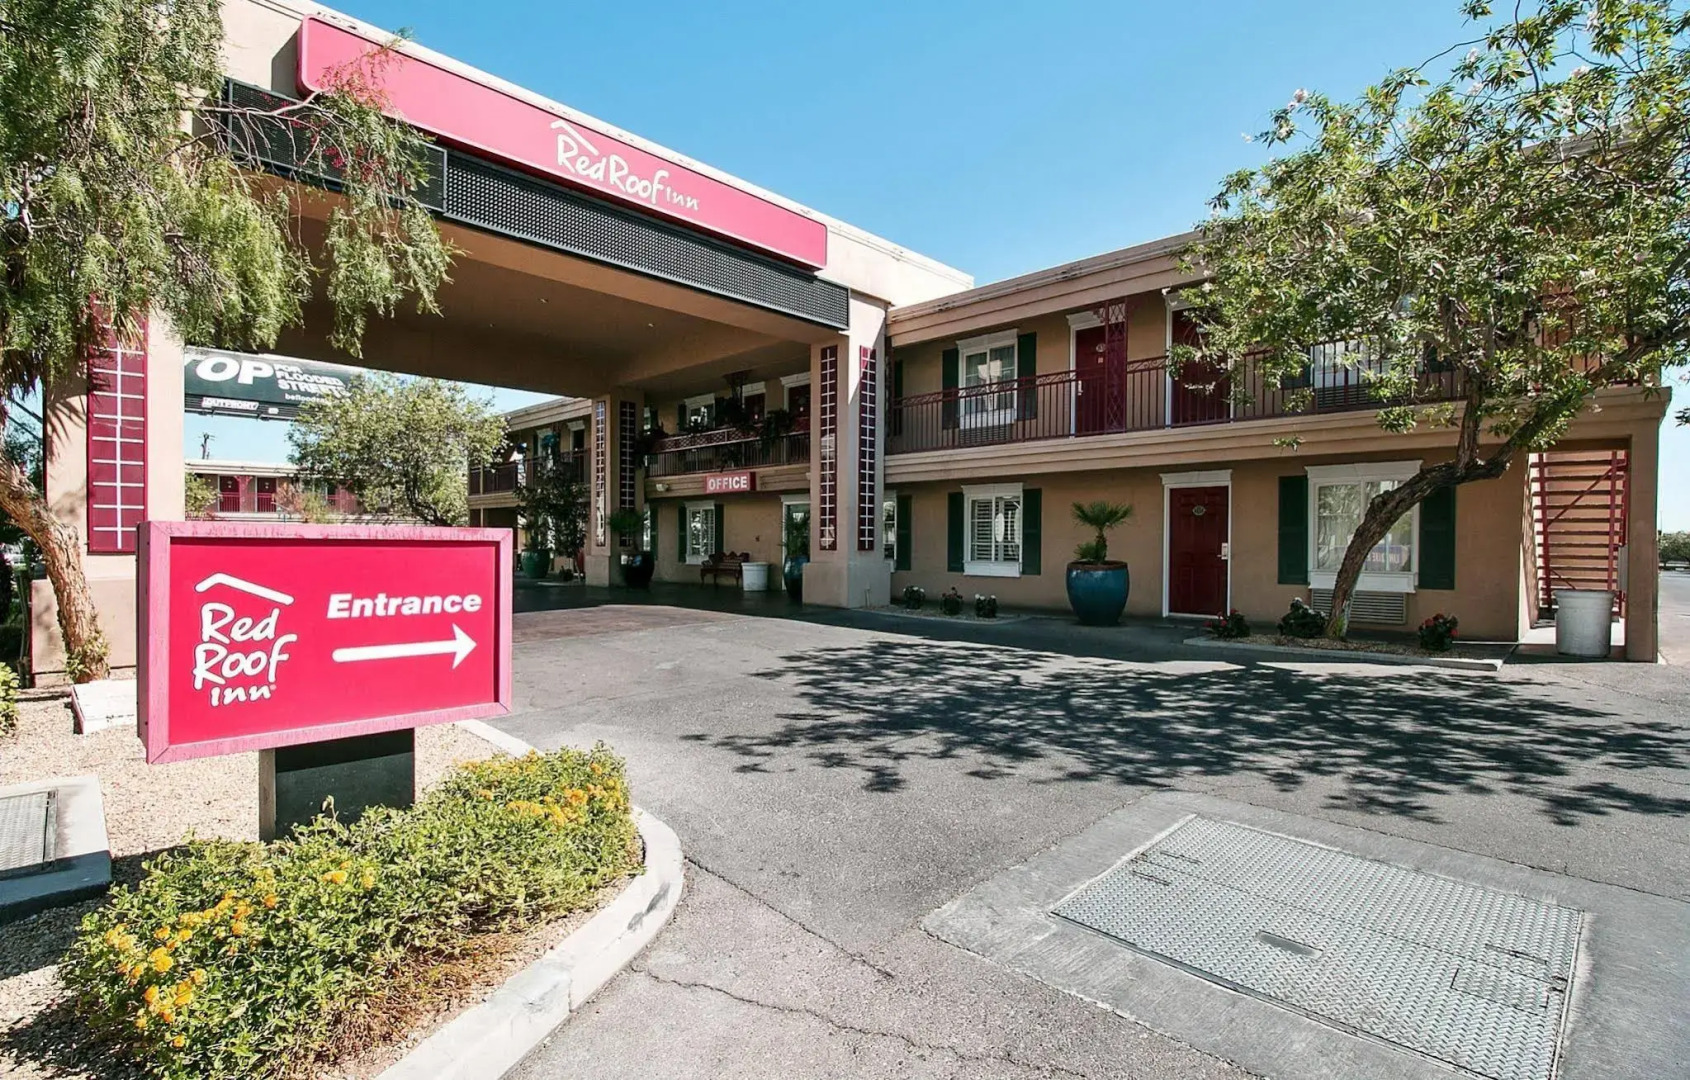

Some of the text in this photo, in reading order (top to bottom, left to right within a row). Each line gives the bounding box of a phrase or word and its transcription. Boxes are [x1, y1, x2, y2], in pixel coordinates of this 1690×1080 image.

[556, 133, 607, 182] Red
[608, 154, 669, 205] Roof
[184, 356, 275, 385] OP
[275, 370, 346, 388] FLOODED
[708, 476, 748, 491] OFFICE
[327, 593, 483, 619] Entrance
[200, 601, 280, 645] Red
[191, 633, 299, 690] Roof
